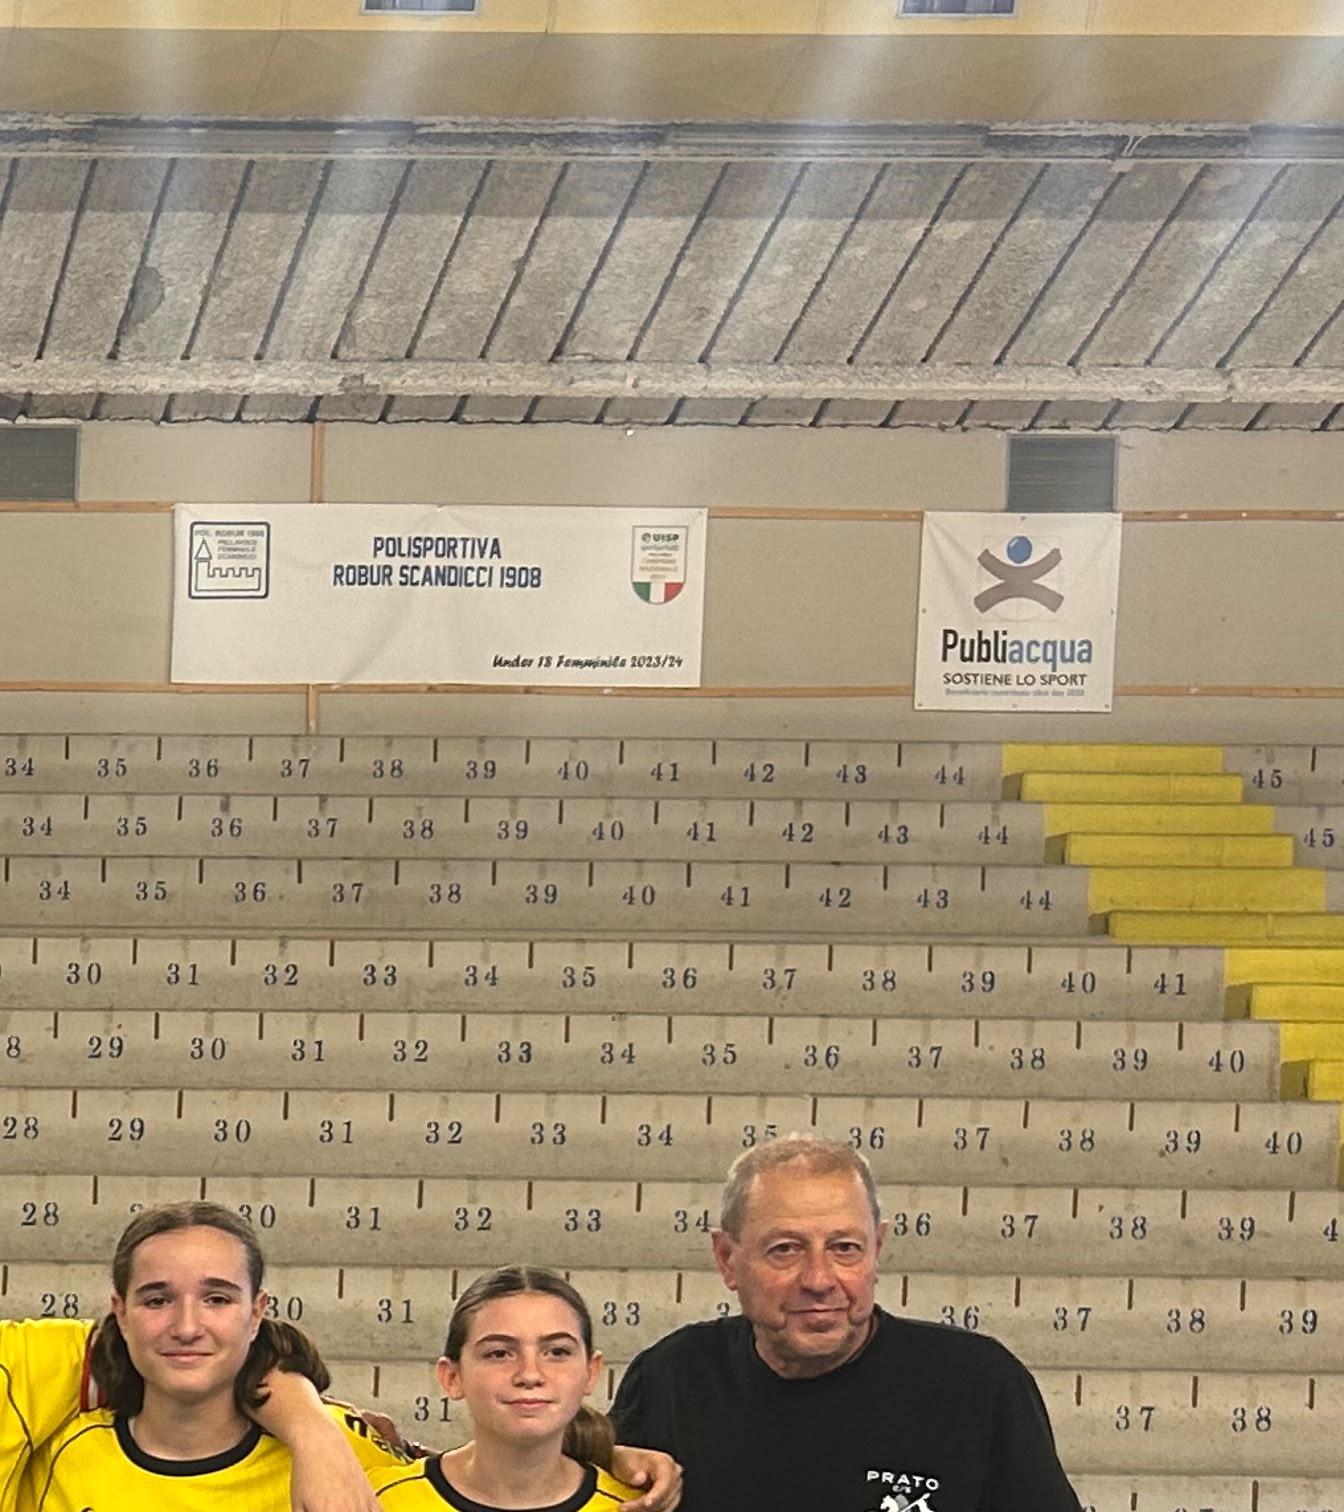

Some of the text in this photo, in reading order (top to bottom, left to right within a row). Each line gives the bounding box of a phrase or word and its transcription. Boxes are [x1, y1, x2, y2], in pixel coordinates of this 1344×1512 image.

[373, 537, 502, 559] POLISPORTIVA
[333, 565, 542, 588] ROBUR SCANDICCI 1908
[493, 654, 534, 668] Under
[538, 655, 552, 668] 18
[630, 655, 683, 668] 2023/24
[941, 629, 1093, 672] Publiacqua
[943, 673, 1087, 686] SOSTIENE LO SPORT
[280, 758, 310, 779] 37
[934, 765, 965, 786] 44
[1252, 769, 1283, 789] 45
[497, 820, 529, 841] 39
[39, 880, 71, 901] 34
[622, 885, 656, 906] 40
[562, 966, 596, 989] 35
[1153, 972, 1187, 996] 41
[600, 1042, 636, 1065] 34
[1208, 1050, 1245, 1074] 40
[213, 1119, 251, 1143] 30
[1058, 1129, 1095, 1153] 38
[20, 1202, 59, 1227] 28
[454, 1207, 492, 1232] 32
[377, 1298, 414, 1324] 31
[1166, 1308, 1206, 1334] 38
[1115, 1405, 1155, 1432] 37
[866, 1470, 941, 1491] PRATO
